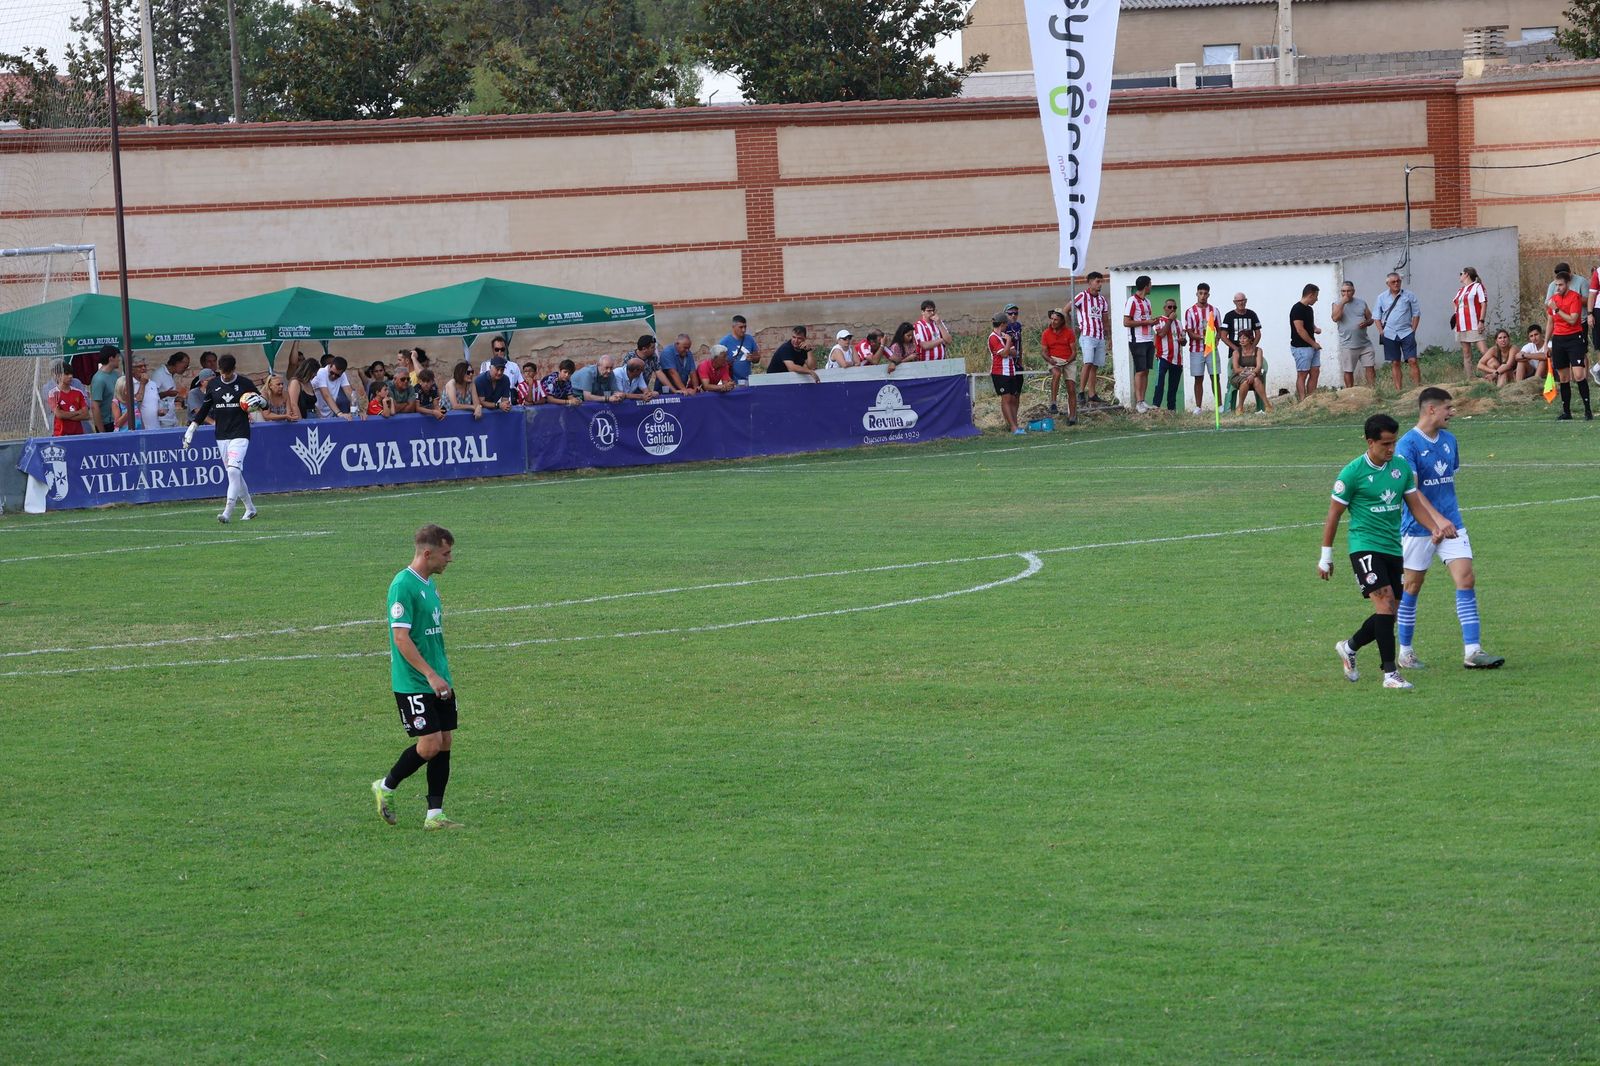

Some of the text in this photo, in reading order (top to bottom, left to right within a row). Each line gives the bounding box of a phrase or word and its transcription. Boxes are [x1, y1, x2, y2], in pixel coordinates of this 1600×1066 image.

[645, 421, 675, 433] Estrella
[868, 414, 904, 429] Revilla
[647, 433, 674, 444] Galicia
[80, 446, 221, 470] AYUNTAMIENTO DE
[341, 434, 498, 473] CAJA RURAL
[81, 465, 225, 495] VILLARALBO
[1358, 554, 1373, 574] 17
[407, 694, 426, 715] 15
